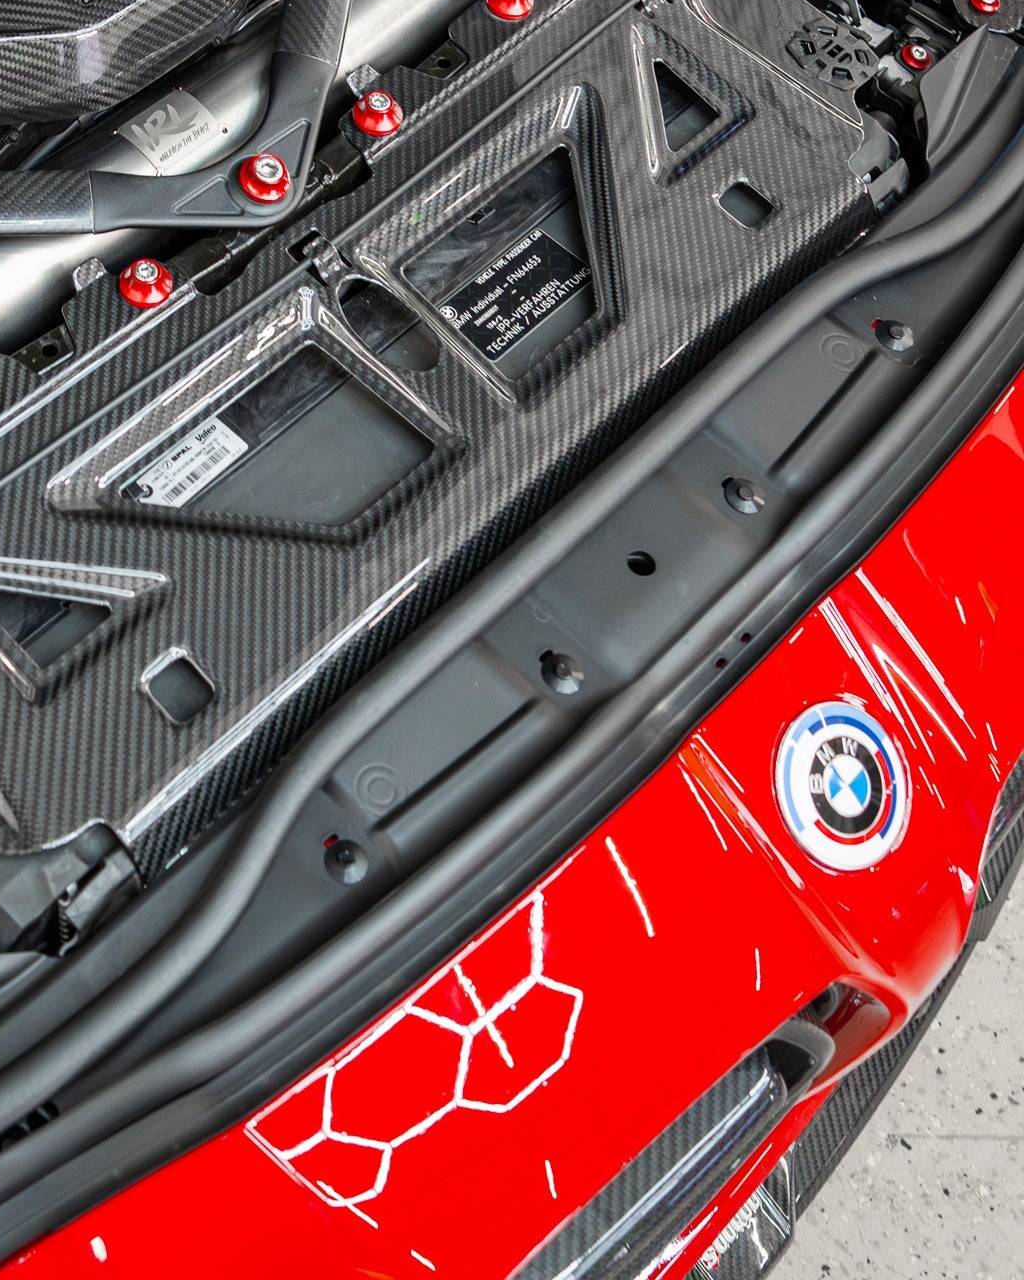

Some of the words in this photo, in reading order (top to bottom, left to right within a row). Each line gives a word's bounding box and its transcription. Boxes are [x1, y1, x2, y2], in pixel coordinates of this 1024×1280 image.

[529, 230, 544, 243] CAR
[452, 310, 473, 330] BMW
[470, 285, 505, 314] Individual
[506, 254, 542, 284] FN64653
[486, 322, 526, 354] TECHNIK
[531, 266, 592, 319] AUSSTATTUNG
[496, 278, 562, 334] IPP-VERFAHREN
[170, 445, 193, 462] SPAL
[195, 424, 218, 442] Valeo
[809, 736, 859, 795] BMW
